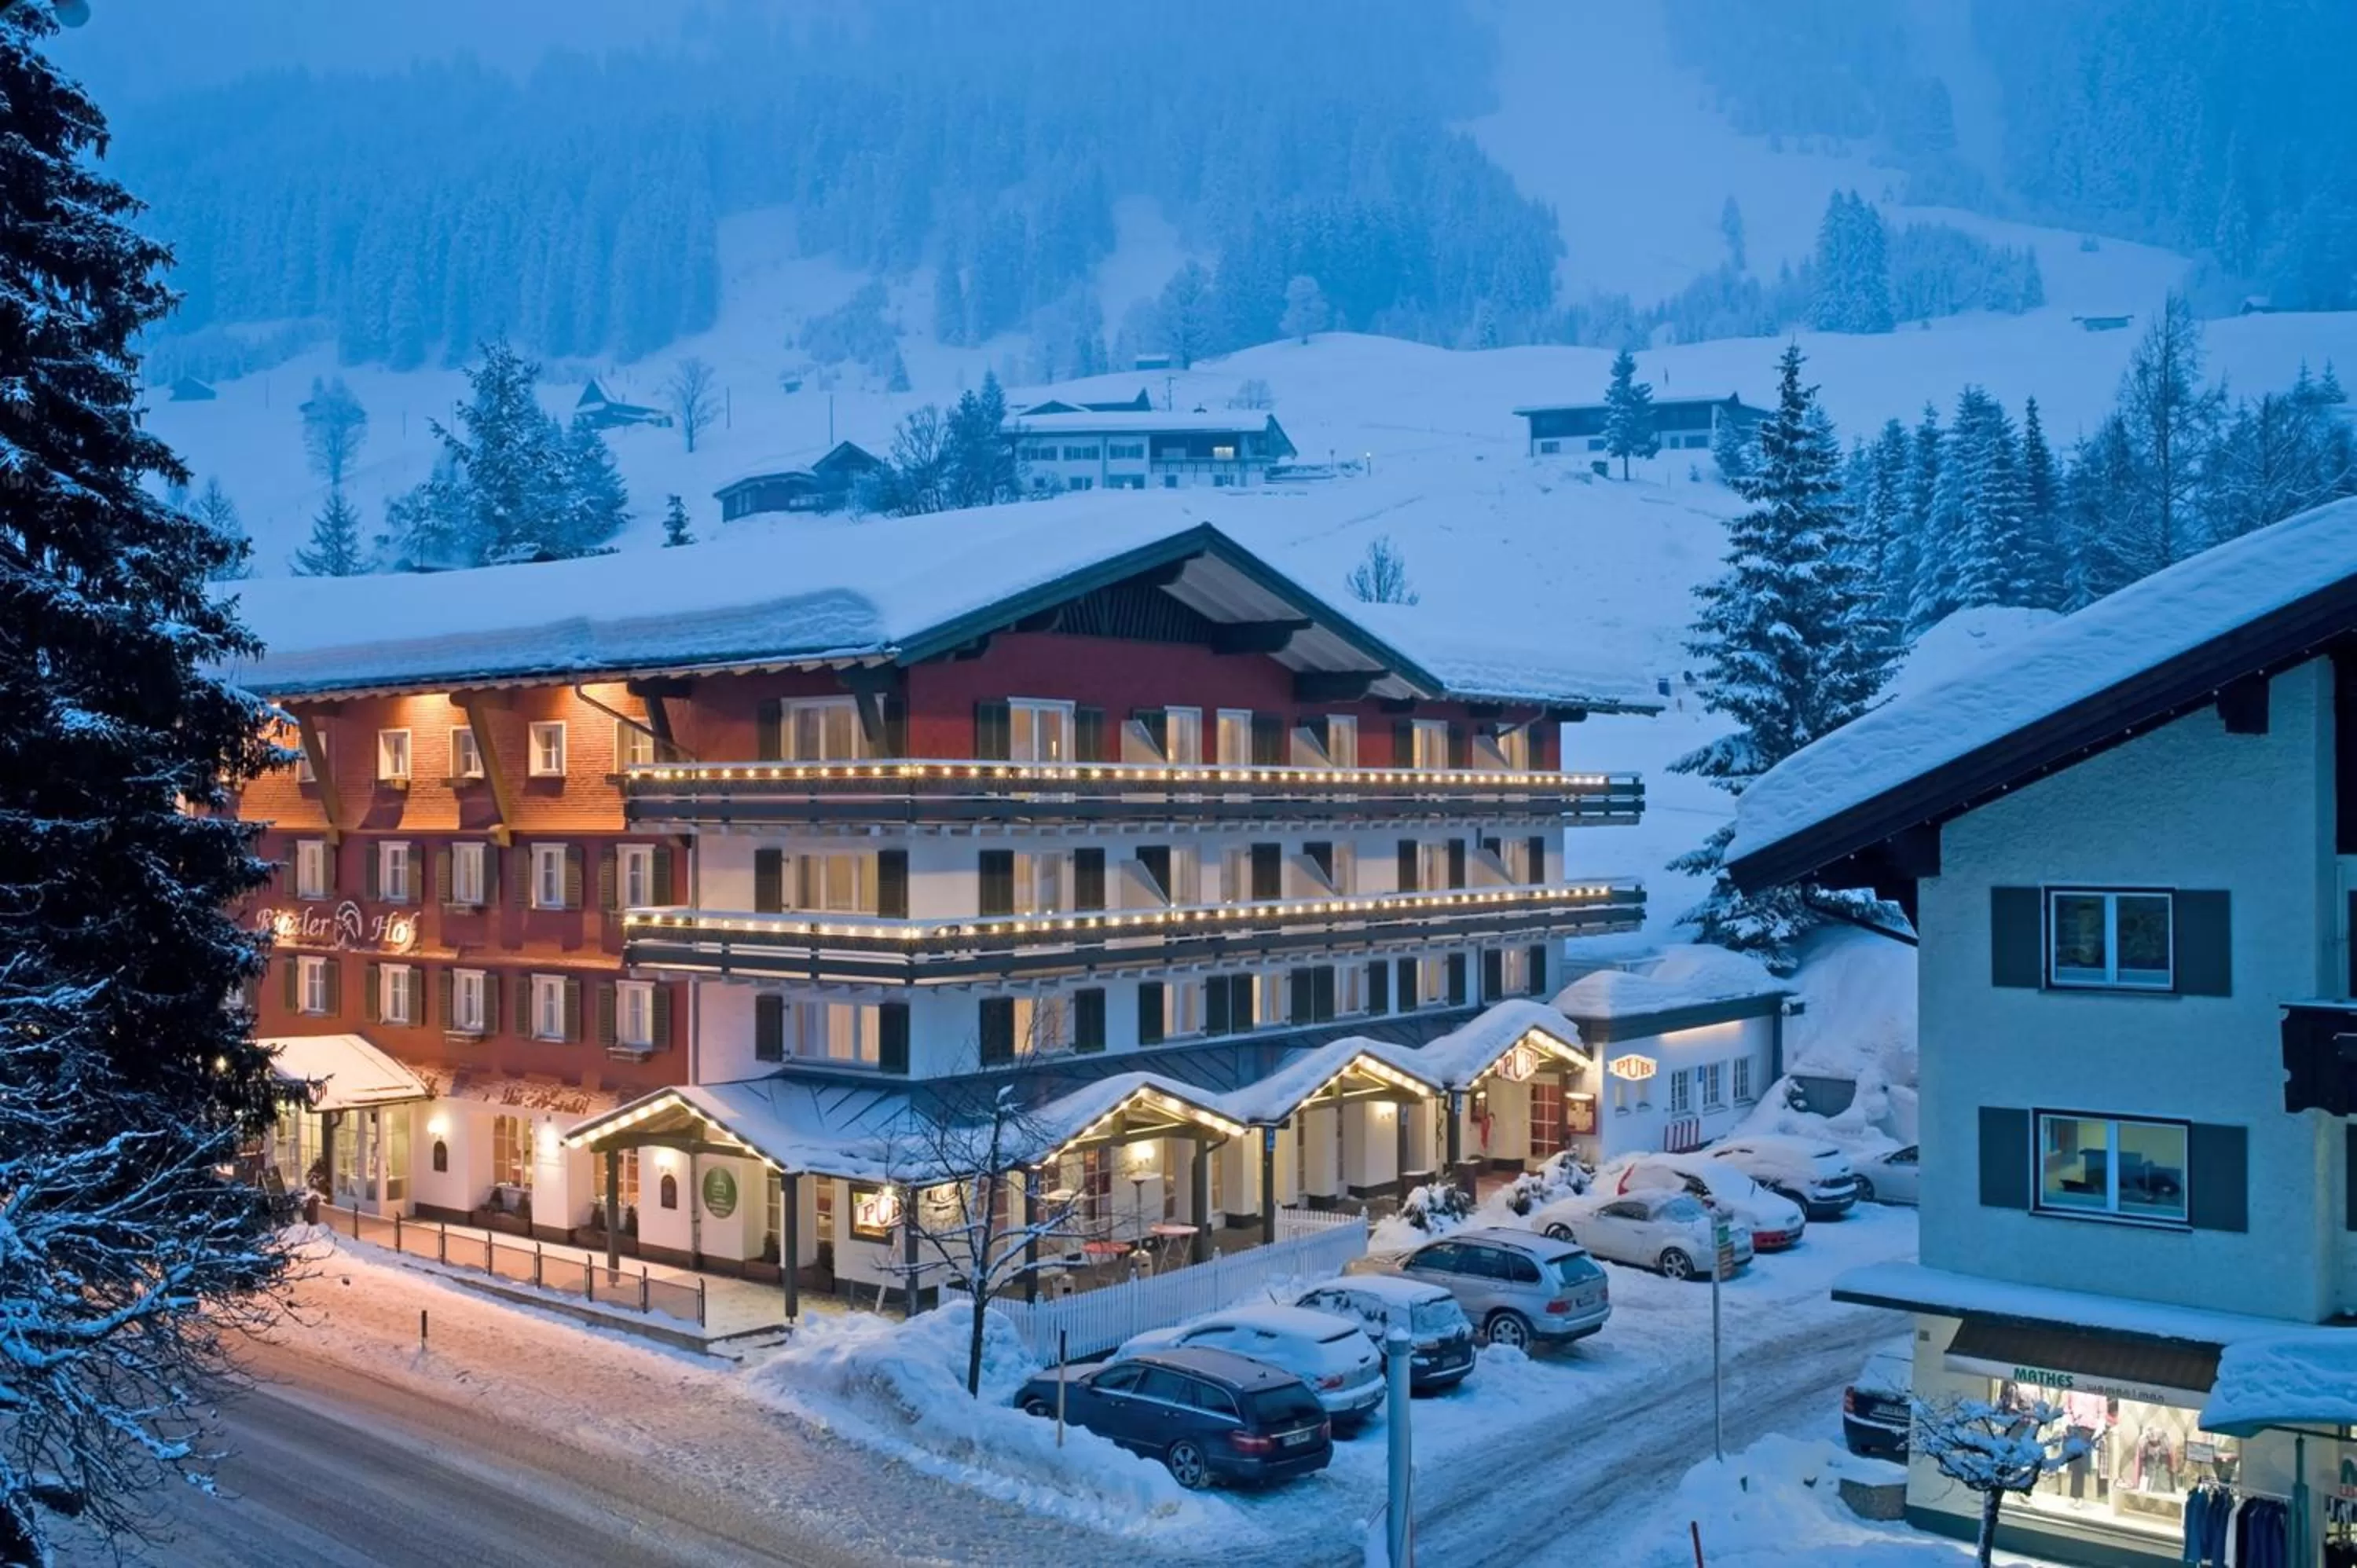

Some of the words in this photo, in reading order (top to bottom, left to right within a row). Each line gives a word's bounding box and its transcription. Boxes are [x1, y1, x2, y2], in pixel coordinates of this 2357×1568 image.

[369, 911, 421, 953] Hof
[1502, 1050, 1534, 1079] PUB
[1616, 1058, 1651, 1079] PUB
[862, 1198, 902, 1225] PUB
[2014, 1368, 2073, 1388] MATHES
